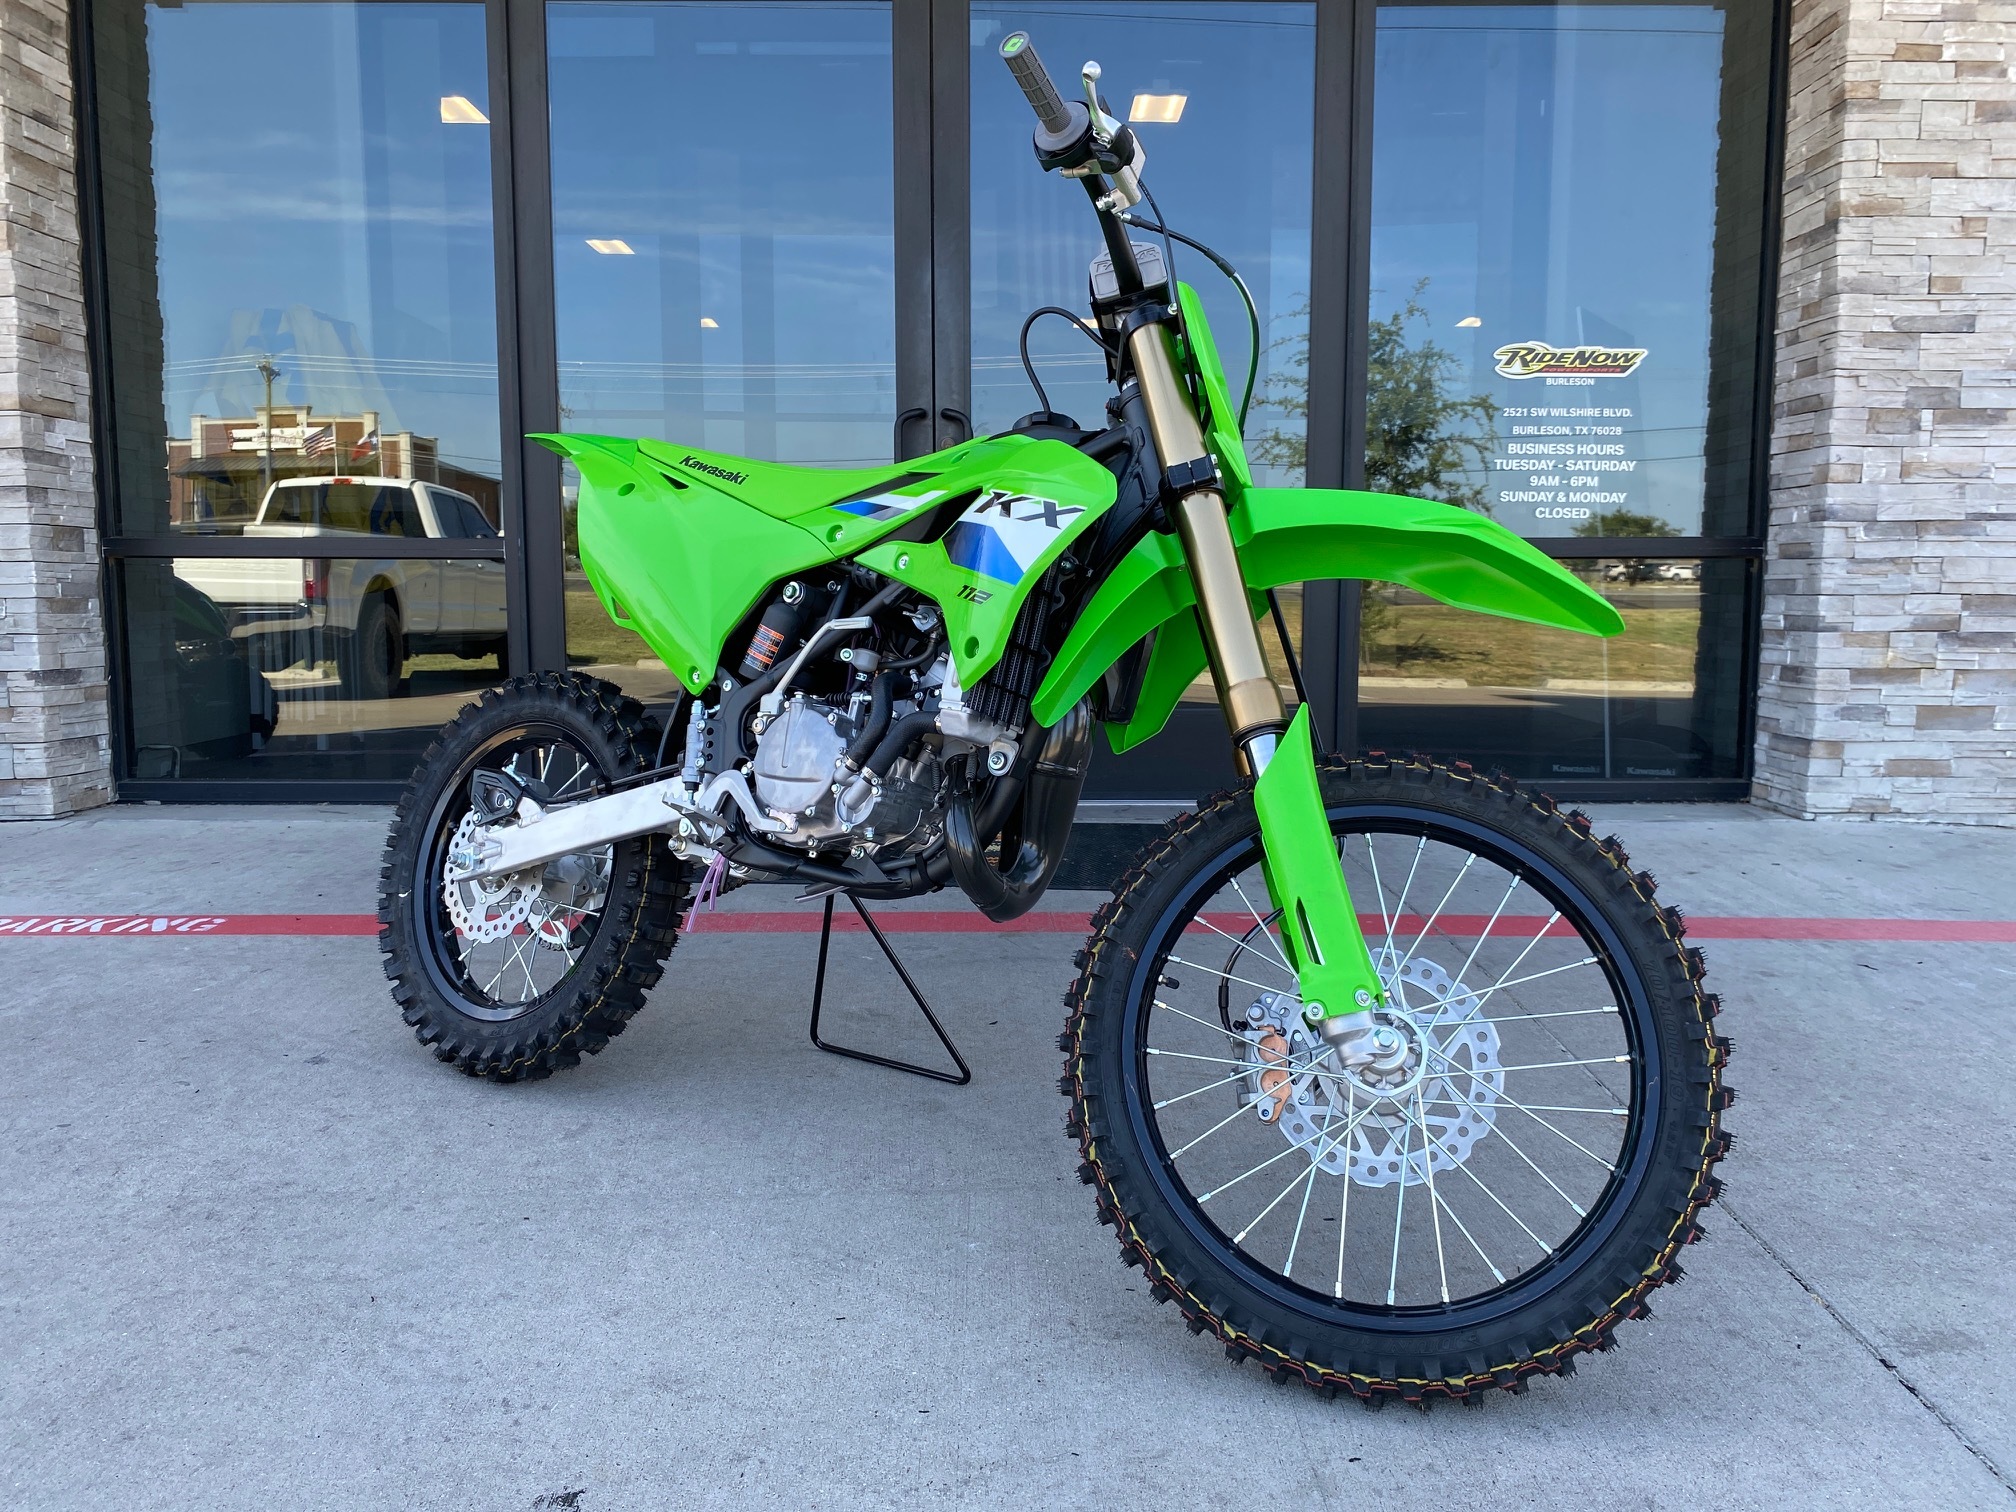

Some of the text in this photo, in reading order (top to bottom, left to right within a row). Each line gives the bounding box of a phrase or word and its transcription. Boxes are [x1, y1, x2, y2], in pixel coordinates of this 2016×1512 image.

[1546, 378, 1595, 386] BURLESON
[1503, 407, 1633, 418] 2521 SW WILSHIRE BLVD.
[1512, 426, 1622, 436] BURLESON, TX 76028
[1507, 443, 1625, 456] BUSINESS HOURS
[678, 455, 750, 486] Kawasaki
[1494, 459, 1556, 471] TUESDAY
[1565, 460, 1636, 472] SATURDAY
[1529, 475, 1560, 487] 9AM
[1570, 475, 1599, 487] 6PM
[1499, 491, 1627, 503] SUNDAY & MONDAY
[973, 490, 1087, 530] KX
[1535, 507, 1590, 519] CLOSED
[956, 584, 994, 605] 112
[1552, 764, 1600, 773] Kawasaki
[1626, 766, 1676, 776] Kawasaki
